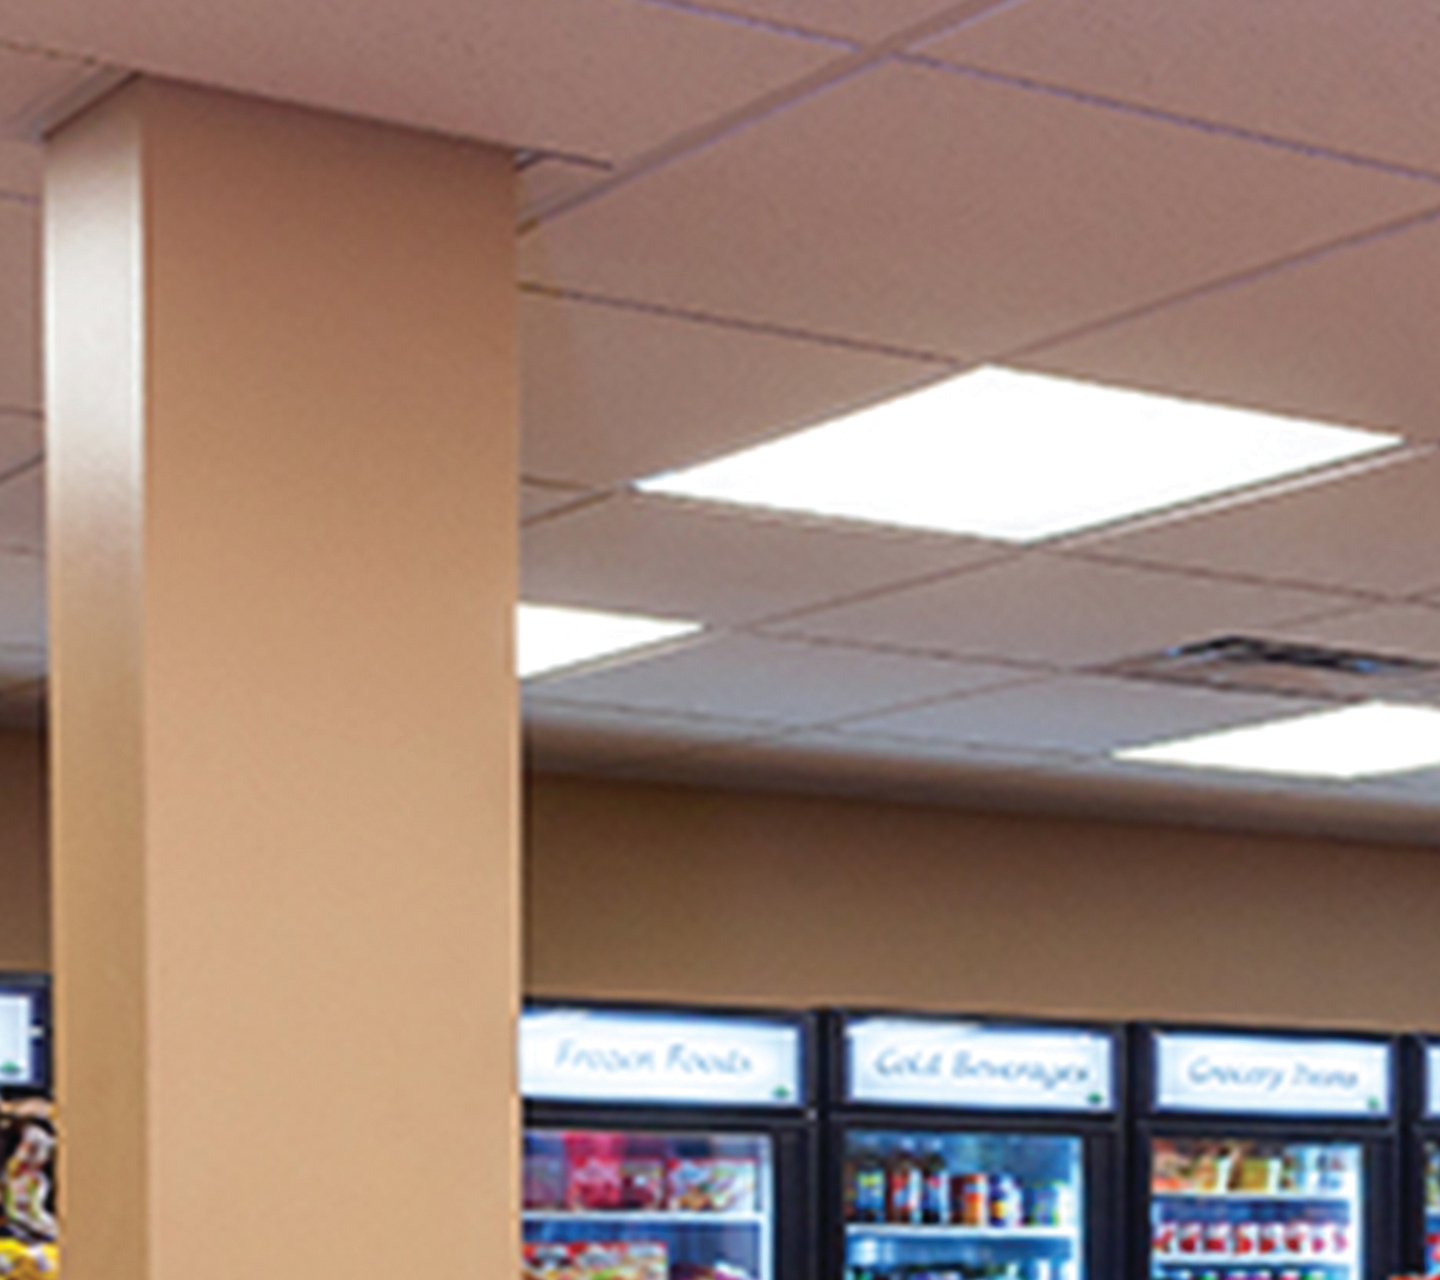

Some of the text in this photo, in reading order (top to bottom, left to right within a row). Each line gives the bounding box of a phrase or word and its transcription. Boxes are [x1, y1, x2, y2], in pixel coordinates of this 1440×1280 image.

[554, 1037, 754, 1076] Frozen Foods
[873, 1045, 1090, 1090] Cold Beverages
[1187, 1056, 1286, 1093] Grocery
